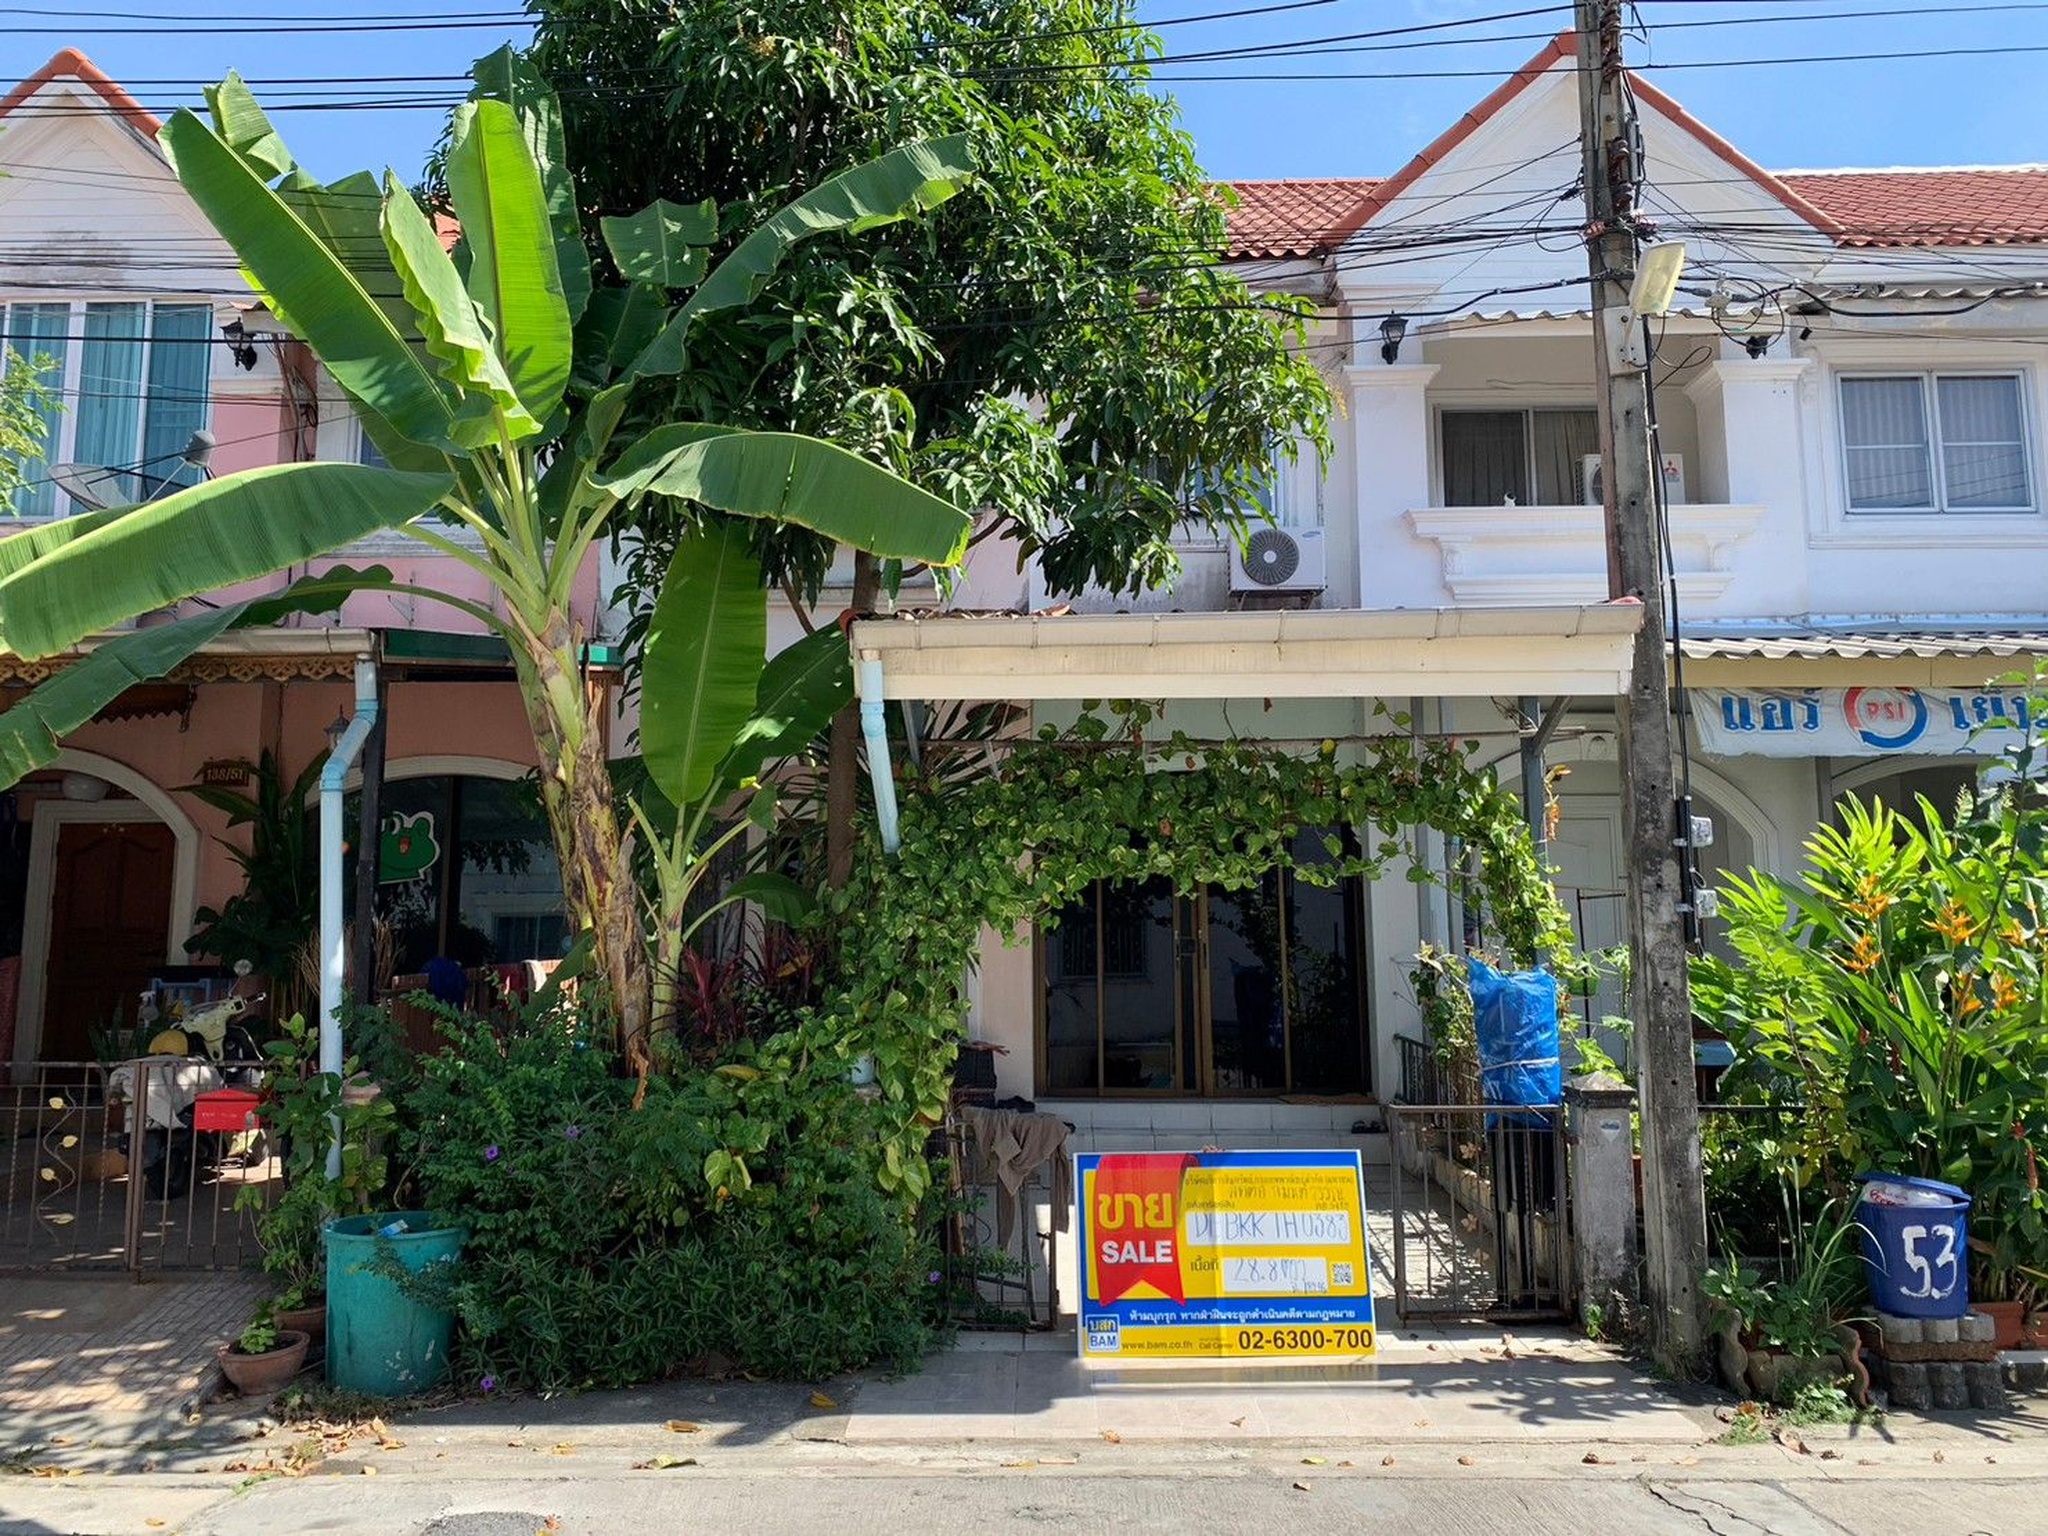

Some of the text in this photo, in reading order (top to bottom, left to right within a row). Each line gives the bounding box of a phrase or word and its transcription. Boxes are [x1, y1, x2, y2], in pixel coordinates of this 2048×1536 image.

[1721, 688, 1820, 731] แอร์
[1866, 702, 1905, 722] PSI
[1098, 1192, 1174, 1230] ขาย
[1101, 1240, 1174, 1264] SALE
[1900, 1225, 1957, 1300] 53
[1129, 1309, 1176, 1325] ห้ามบุกรุก
[1090, 1335, 1117, 1347] BAM
[1122, 1340, 1193, 1350] www.bam.co.th
[1238, 1329, 1373, 1350] 02-6300-700
